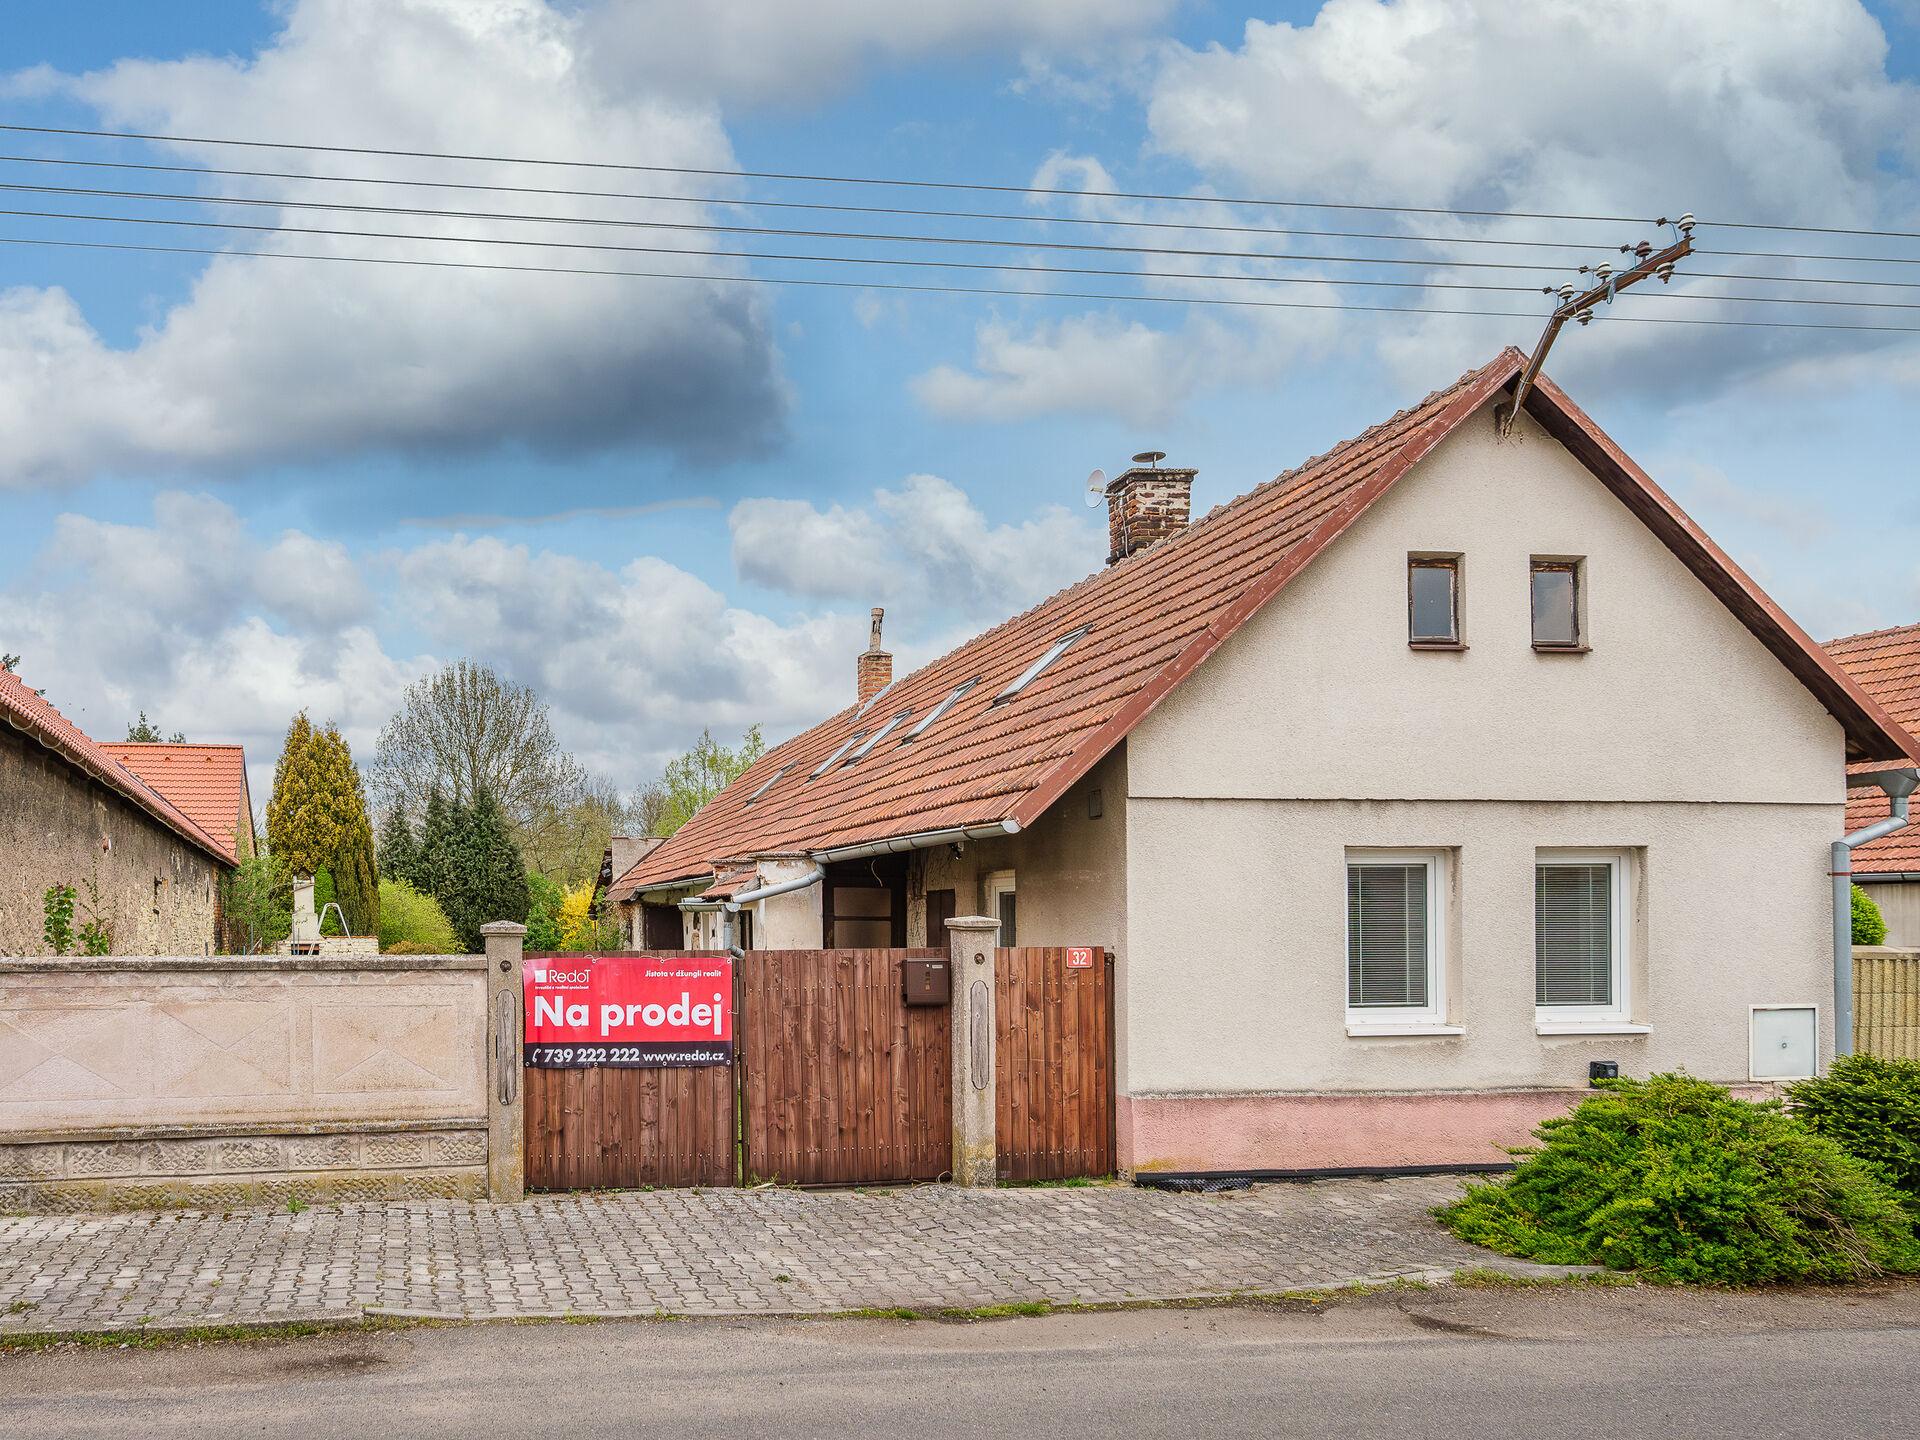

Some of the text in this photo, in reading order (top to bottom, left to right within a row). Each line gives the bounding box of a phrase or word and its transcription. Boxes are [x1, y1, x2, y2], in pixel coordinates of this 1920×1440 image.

[1072, 951, 1087, 965] 32
[534, 992, 722, 1036] Na prodej
[544, 1047, 725, 1063] 739 222 222 www.redot.cz
